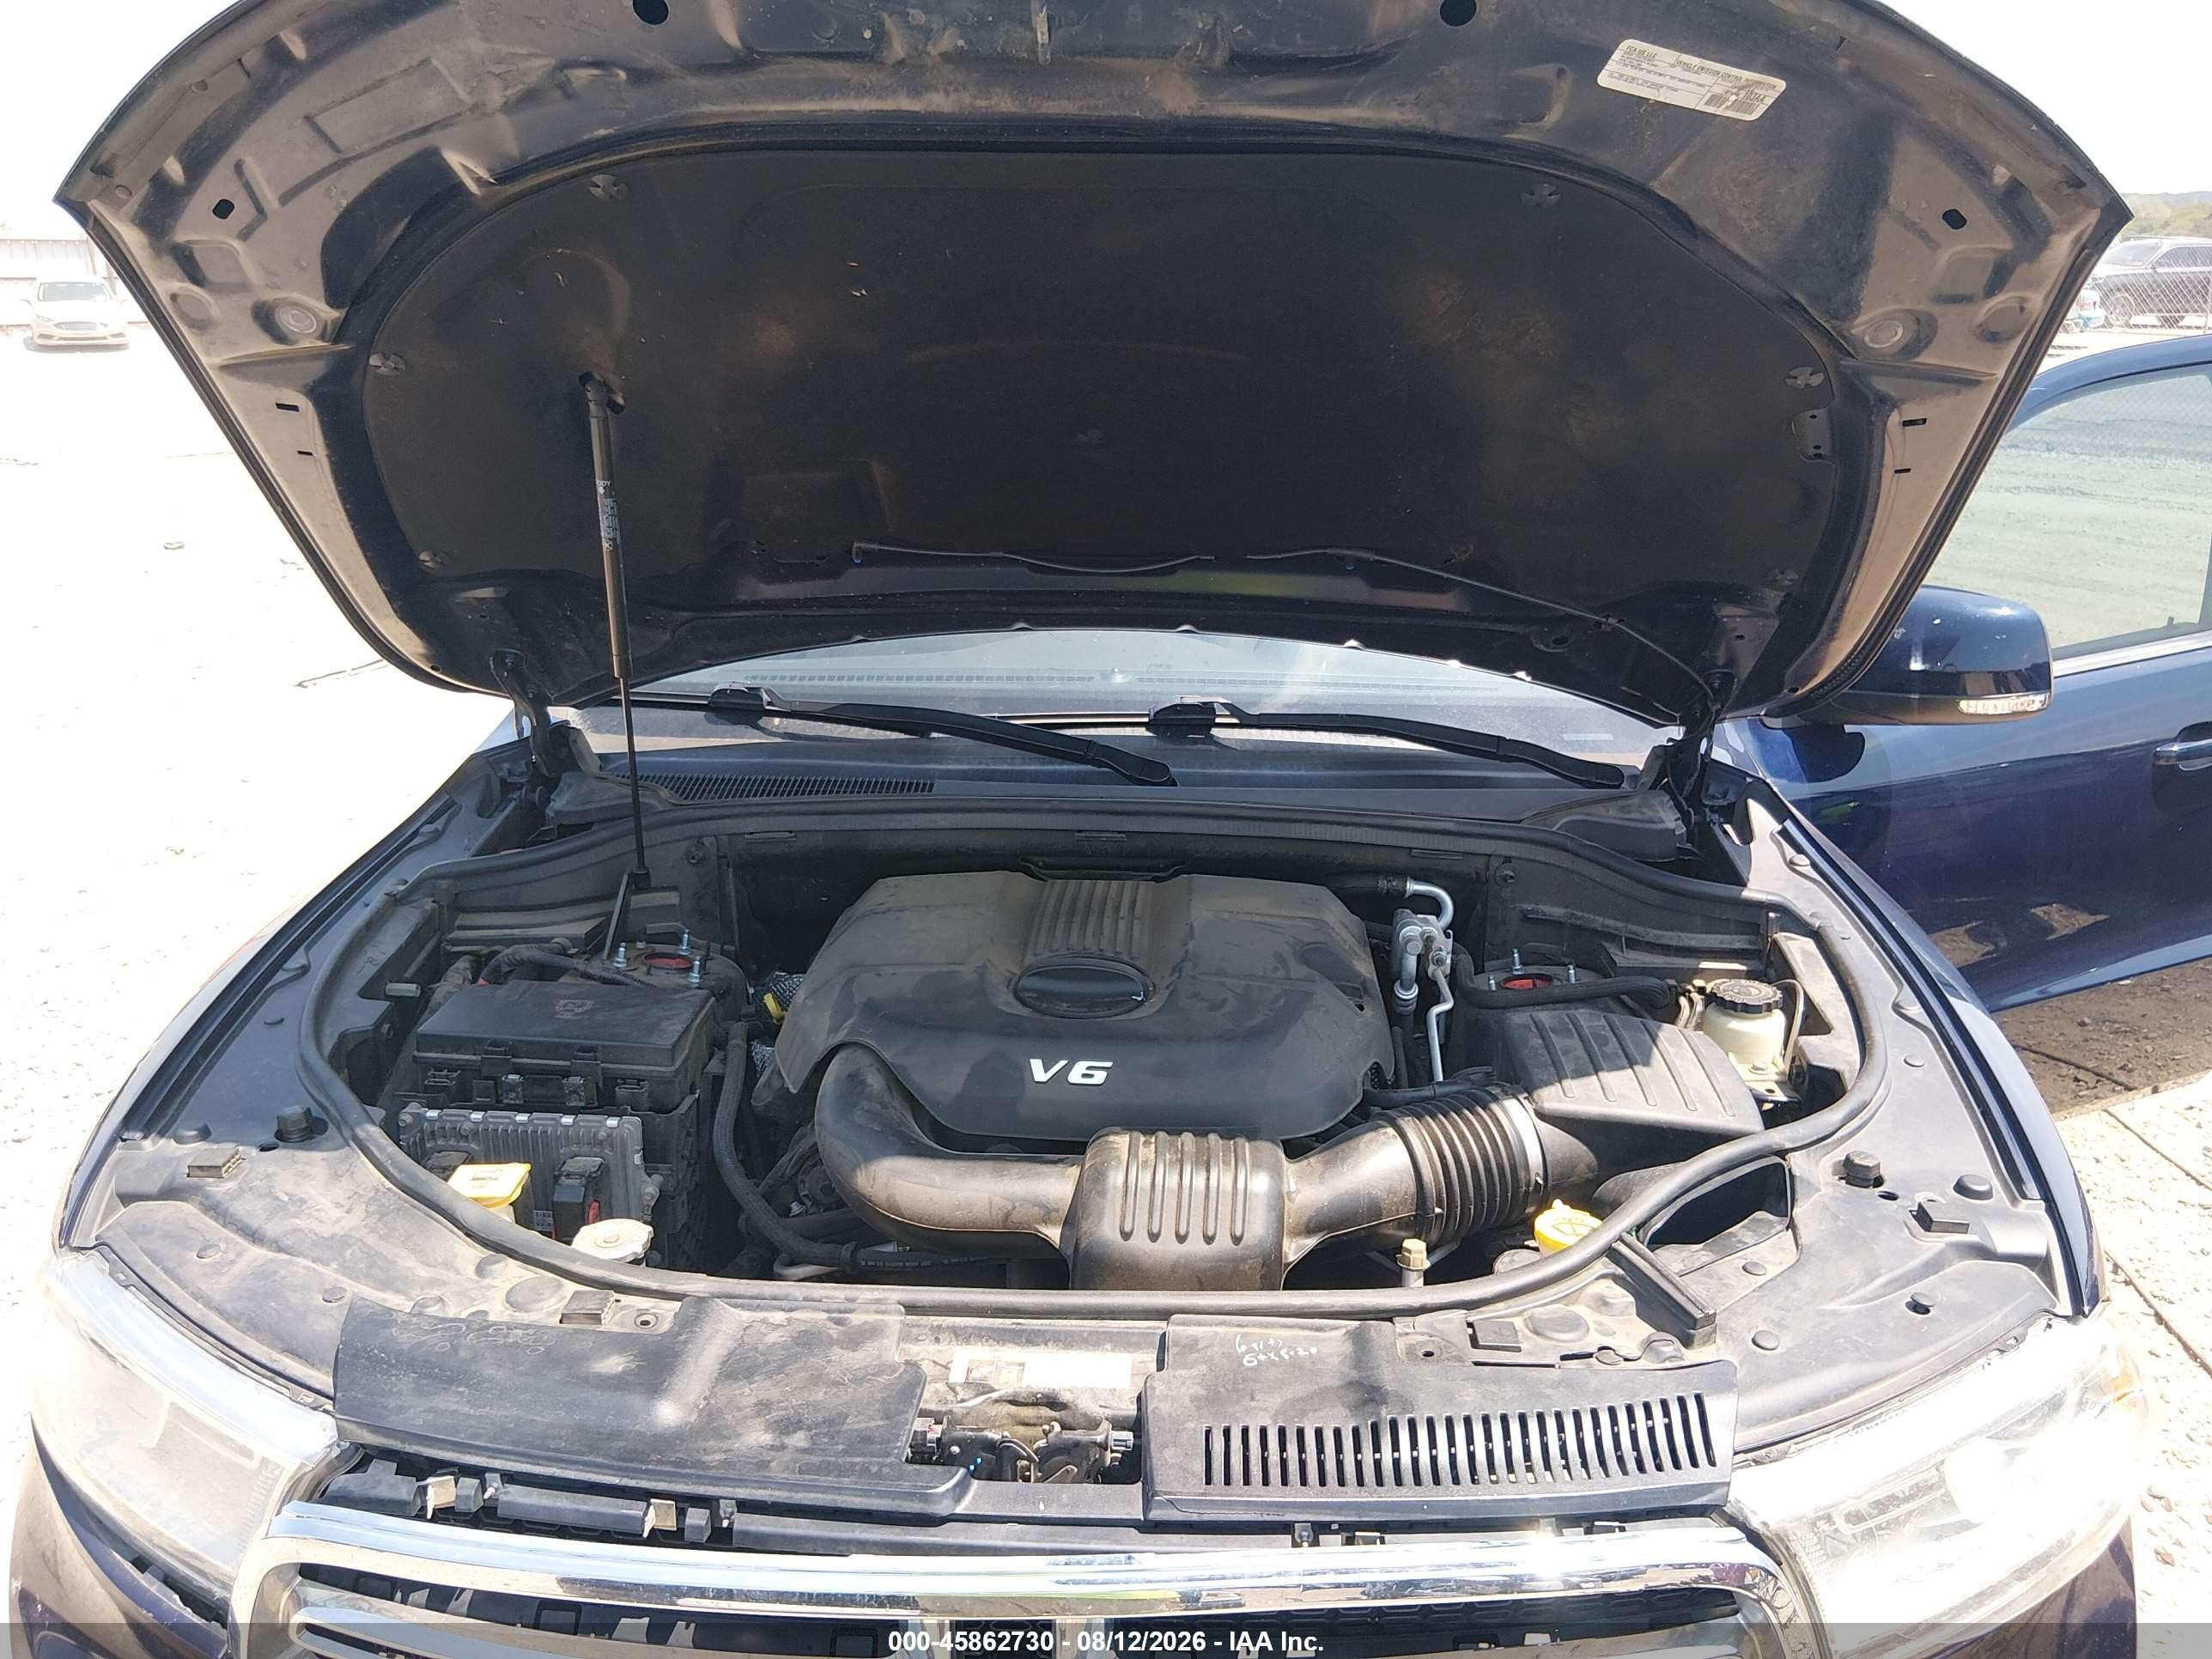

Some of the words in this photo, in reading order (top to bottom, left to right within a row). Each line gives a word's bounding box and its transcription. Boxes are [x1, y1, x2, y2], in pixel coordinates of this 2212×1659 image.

[1626, 45, 1637, 53] FCA
[1646, 50, 1657, 58] LLC
[1676, 60, 1696, 70] VEHICLE
[1697, 65, 1719, 76] EMISSION
[1720, 71, 1742, 82] CONTROL
[1030, 1058, 1114, 1085] V6
